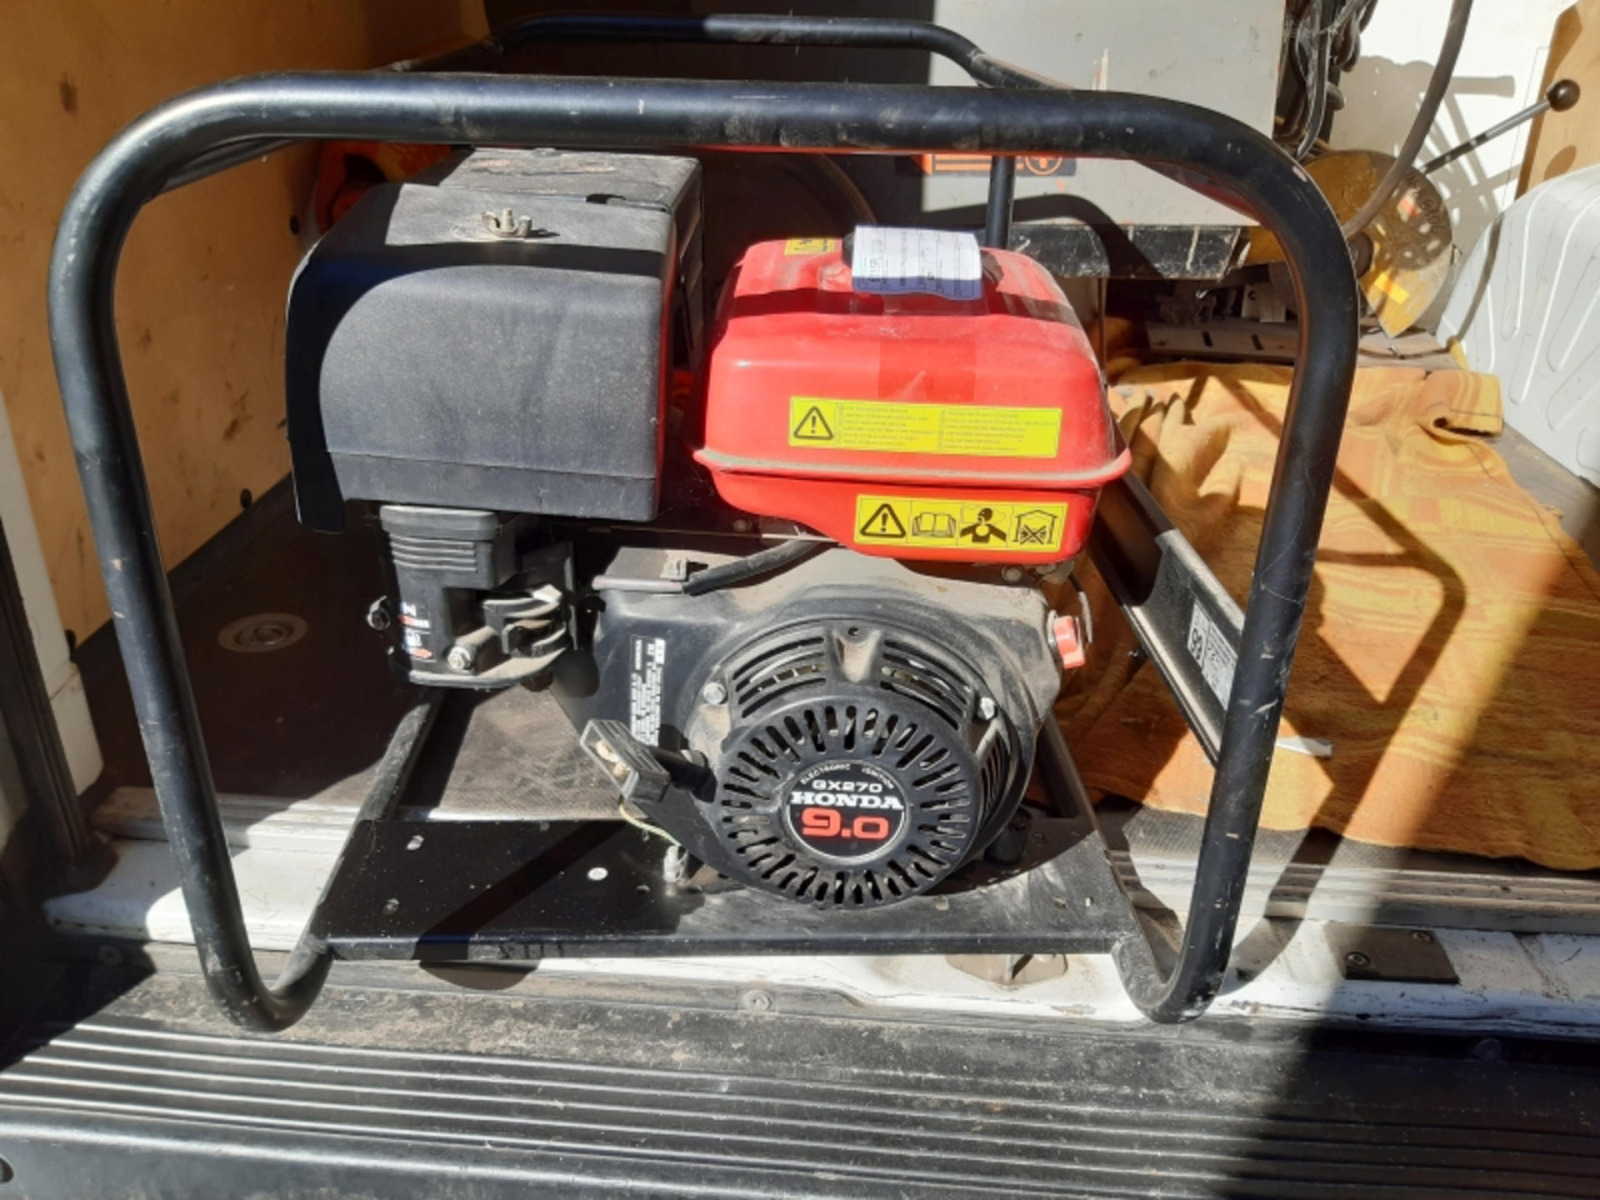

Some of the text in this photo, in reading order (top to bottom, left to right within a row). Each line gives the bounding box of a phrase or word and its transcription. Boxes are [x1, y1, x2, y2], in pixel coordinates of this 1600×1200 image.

[812, 779, 883, 793] GX270
[790, 791, 904, 810] HONDA
[801, 807, 889, 839] 9.0
